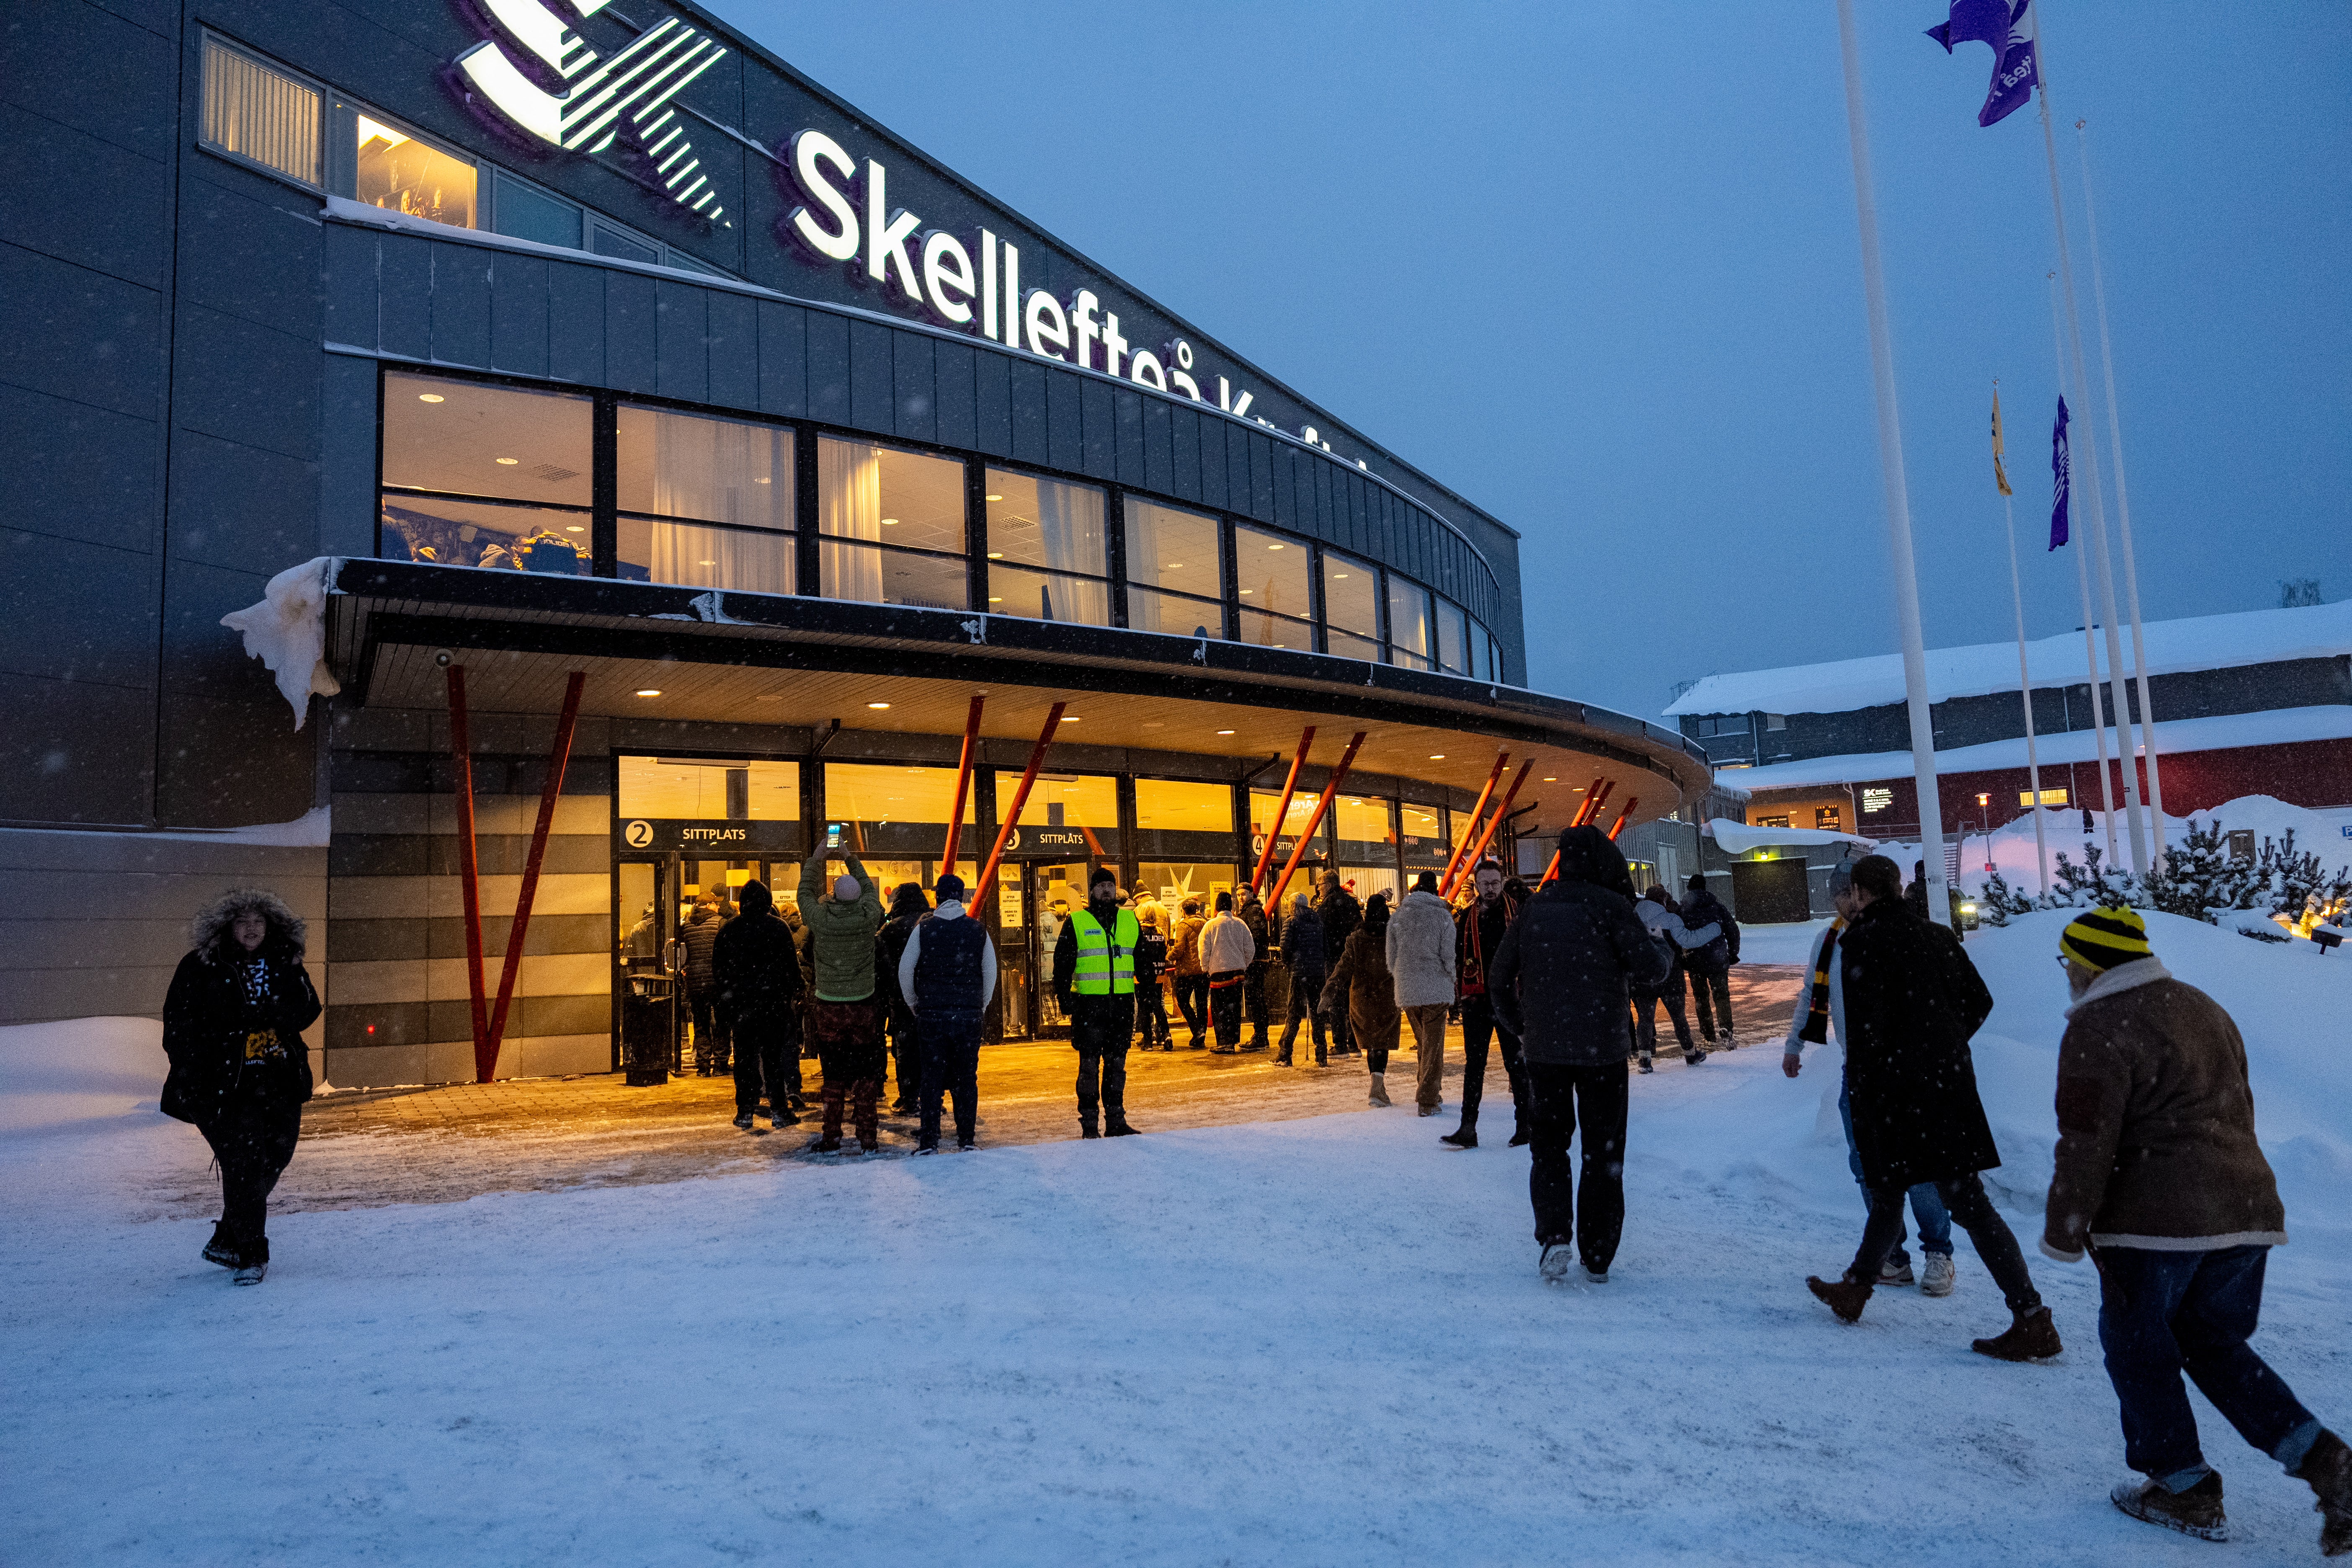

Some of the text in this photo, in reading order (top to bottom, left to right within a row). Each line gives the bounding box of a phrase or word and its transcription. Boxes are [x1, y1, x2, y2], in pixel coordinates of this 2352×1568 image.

[1864, 789, 1876, 797] SK
[633, 823, 745, 844] 2 SITTPLATS
[2345, 826, 2352, 836] P
[1040, 834, 1083, 844] SITTPLATS
[1256, 838, 1298, 853] 4 SITTPLA
